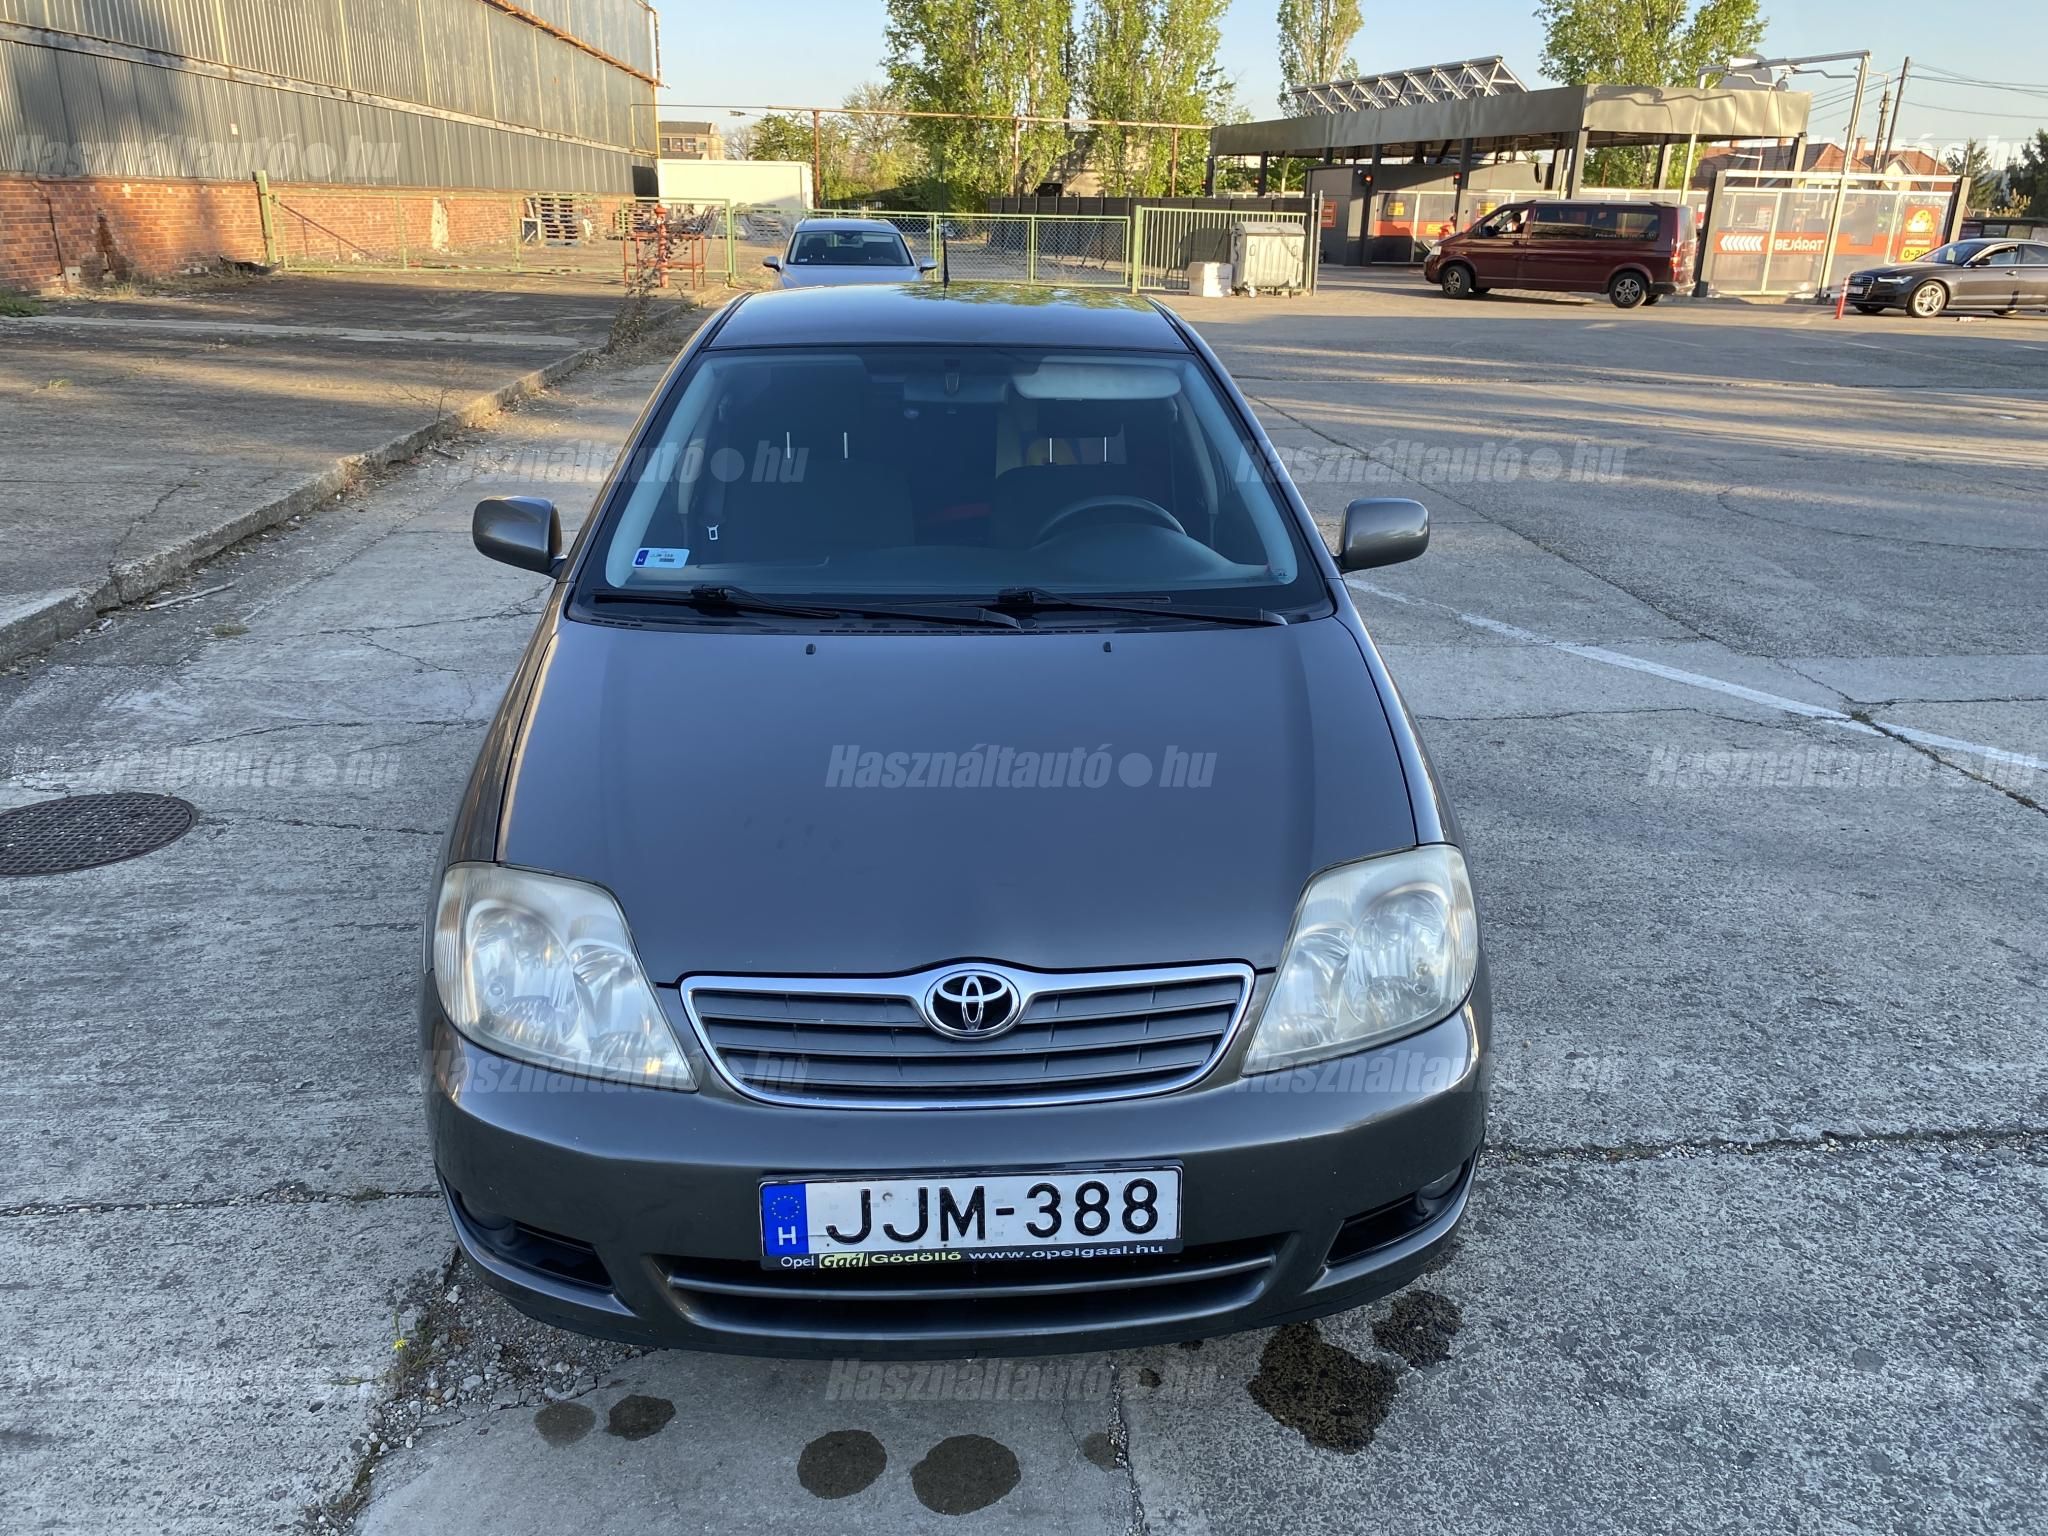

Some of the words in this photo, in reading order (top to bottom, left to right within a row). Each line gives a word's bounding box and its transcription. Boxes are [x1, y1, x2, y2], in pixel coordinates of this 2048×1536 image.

[1774, 236, 1824, 251] BEJÁRAT
[778, 1226, 797, 1245] H
[825, 1178, 1159, 1245] JJM-388
[780, 1255, 815, 1269] Opel
[871, 1252, 962, 1264] Gödöllő
[968, 1244, 1163, 1259] www.opelgaal.hu
